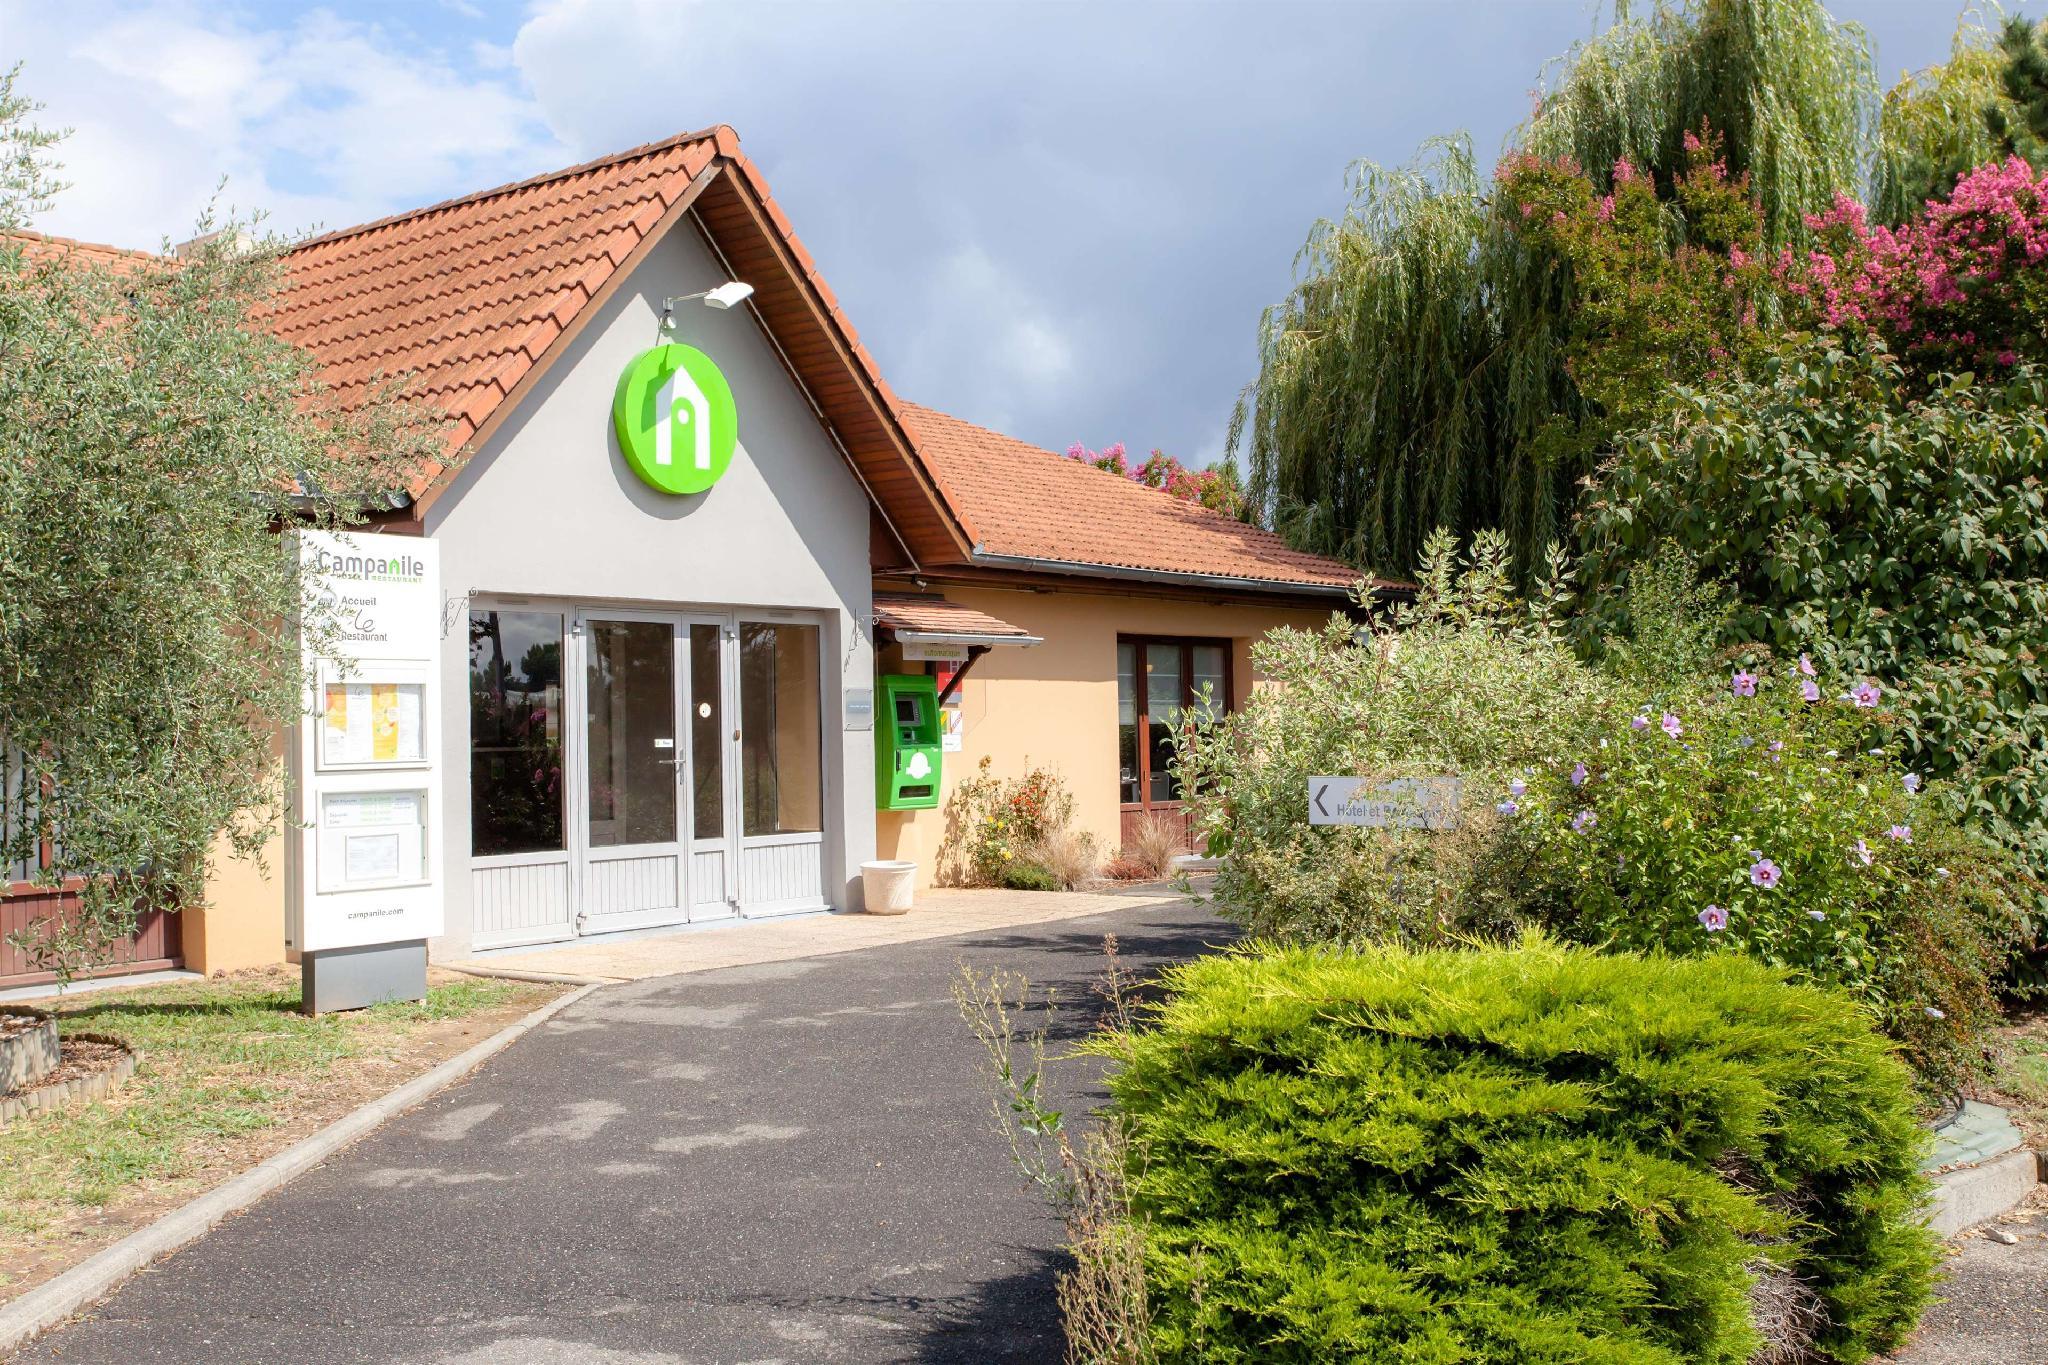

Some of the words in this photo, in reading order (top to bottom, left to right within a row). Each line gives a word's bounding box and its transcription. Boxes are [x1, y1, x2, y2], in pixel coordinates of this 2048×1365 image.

[318, 551, 424, 581] Campanile
[341, 596, 377, 606] Accueil
[341, 631, 388, 642] Restaurant
[1369, 805, 1380, 817] et
[347, 908, 404, 919] campanile.com
